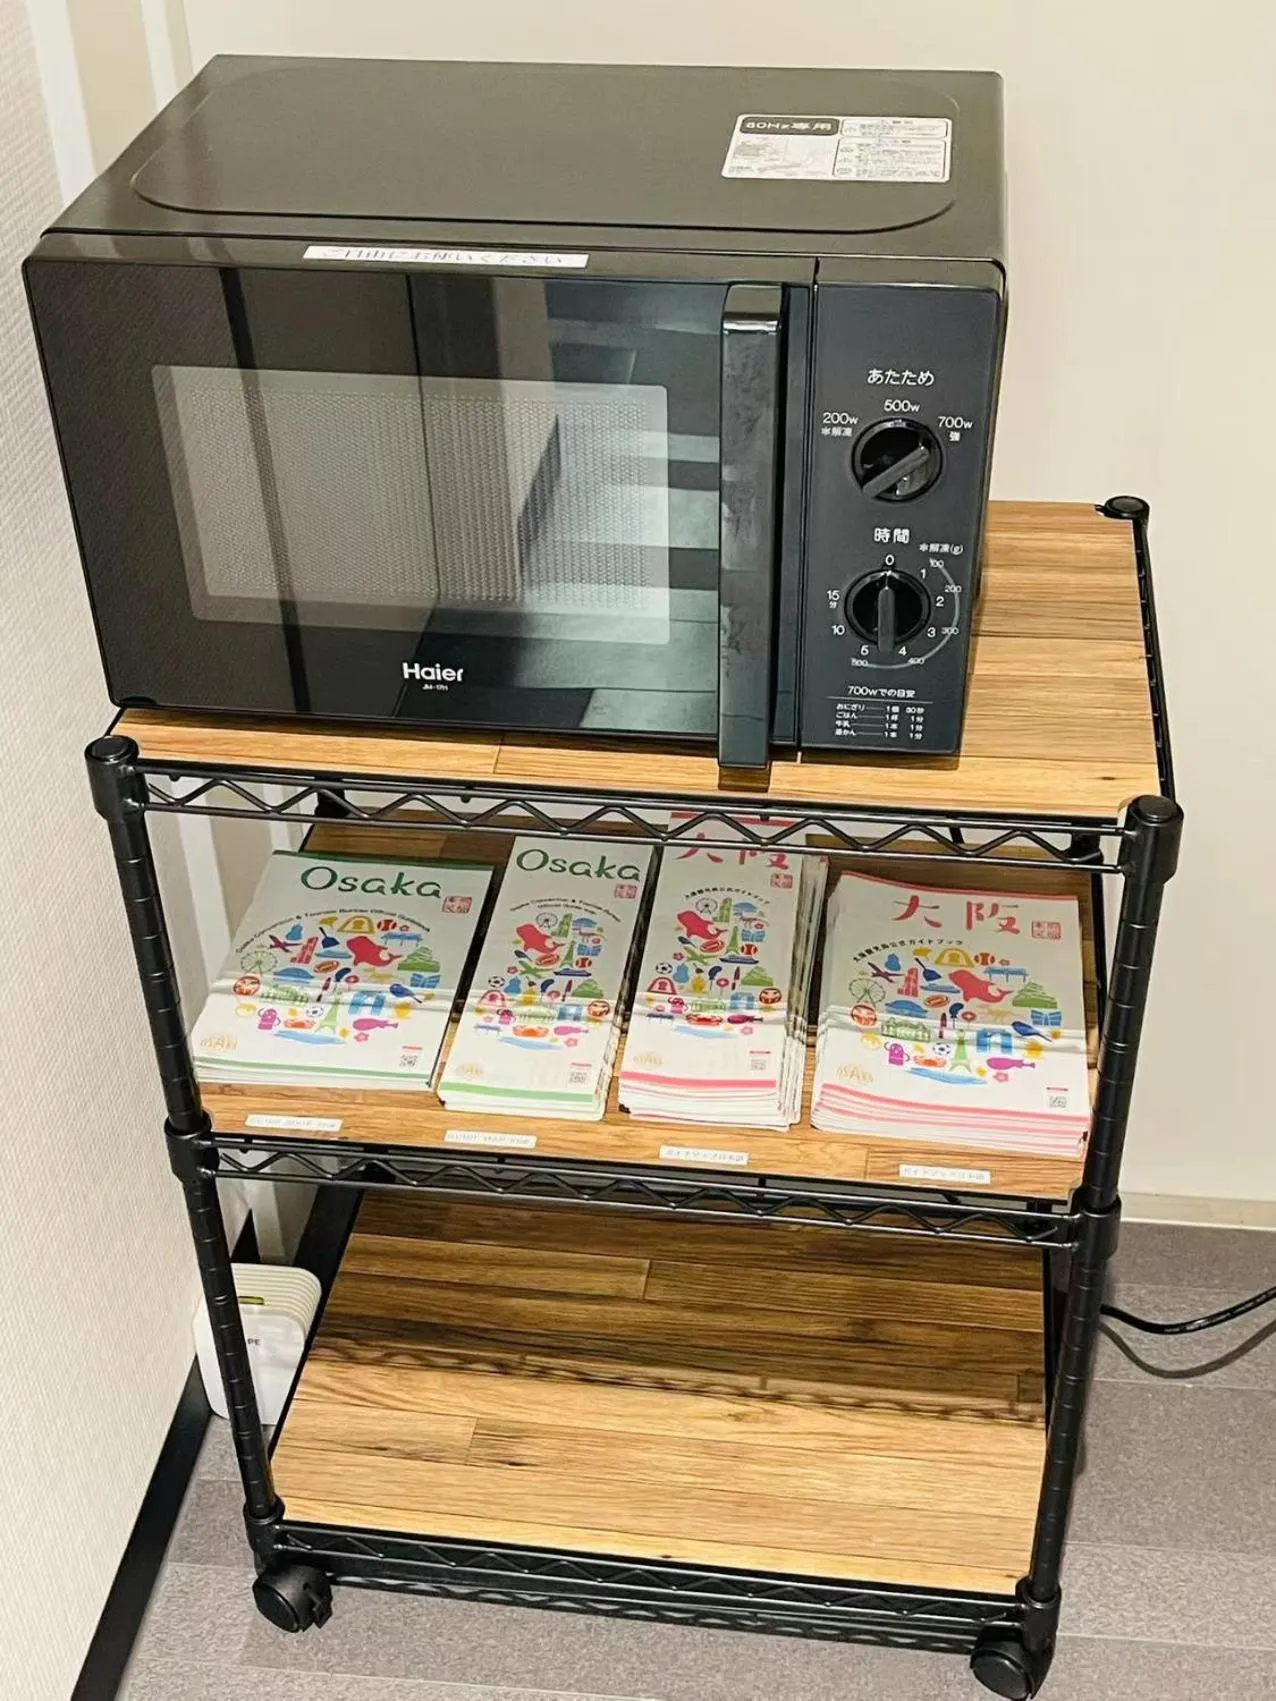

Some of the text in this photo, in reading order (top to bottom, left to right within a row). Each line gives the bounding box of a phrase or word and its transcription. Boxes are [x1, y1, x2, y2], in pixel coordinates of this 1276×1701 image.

[867, 368, 935, 387] あたため
[873, 528, 910, 544] 時間
[885, 555, 895, 566] 0
[920, 567, 927, 580] 1
[944, 584, 962, 593] 200
[826, 590, 840, 601] 15
[935, 595, 945, 607] 2
[831, 624, 846, 636] 10
[927, 626, 936, 638] 3
[898, 645, 908, 656] 4
[402, 662, 464, 682] Haier
[516, 849, 640, 882] Osaka
[300, 866, 441, 898] Osaka
[892, 895, 1021, 935] 大阪
